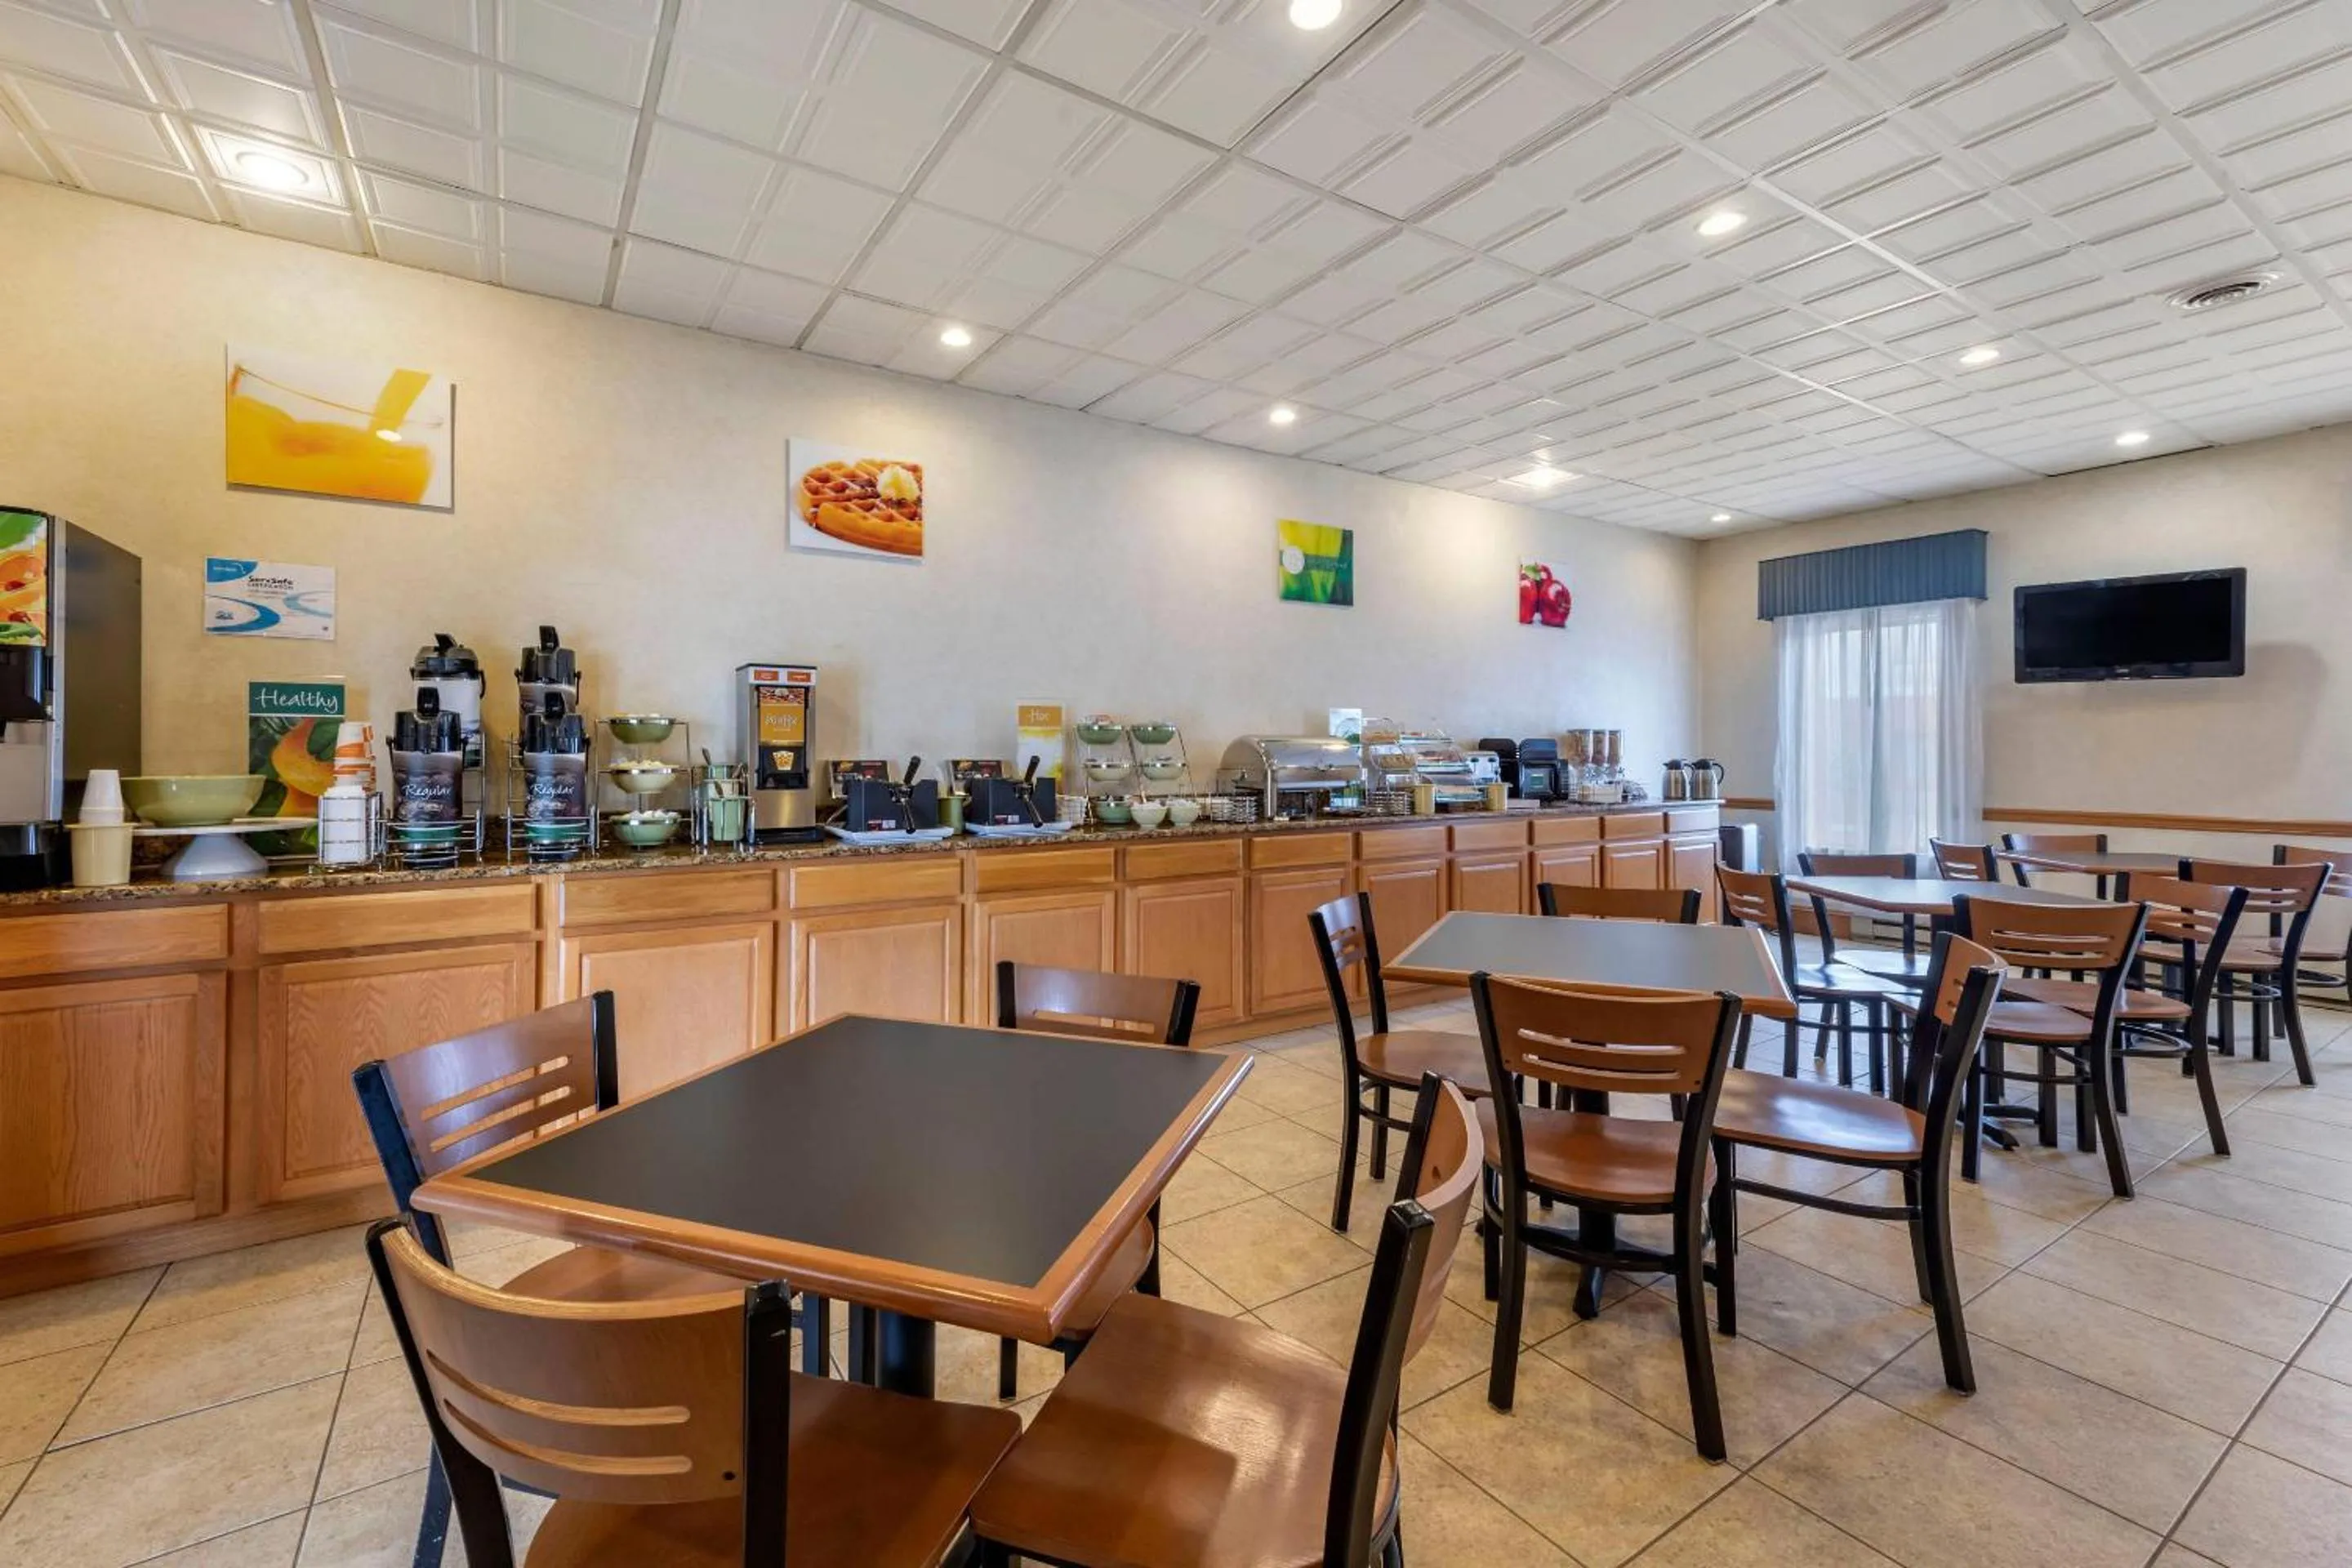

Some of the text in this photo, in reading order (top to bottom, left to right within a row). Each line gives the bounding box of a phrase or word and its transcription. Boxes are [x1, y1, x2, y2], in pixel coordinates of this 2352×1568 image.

[255, 687, 338, 714] Healthy
[402, 783, 452, 800] Regular
[530, 783, 575, 799] Regular
